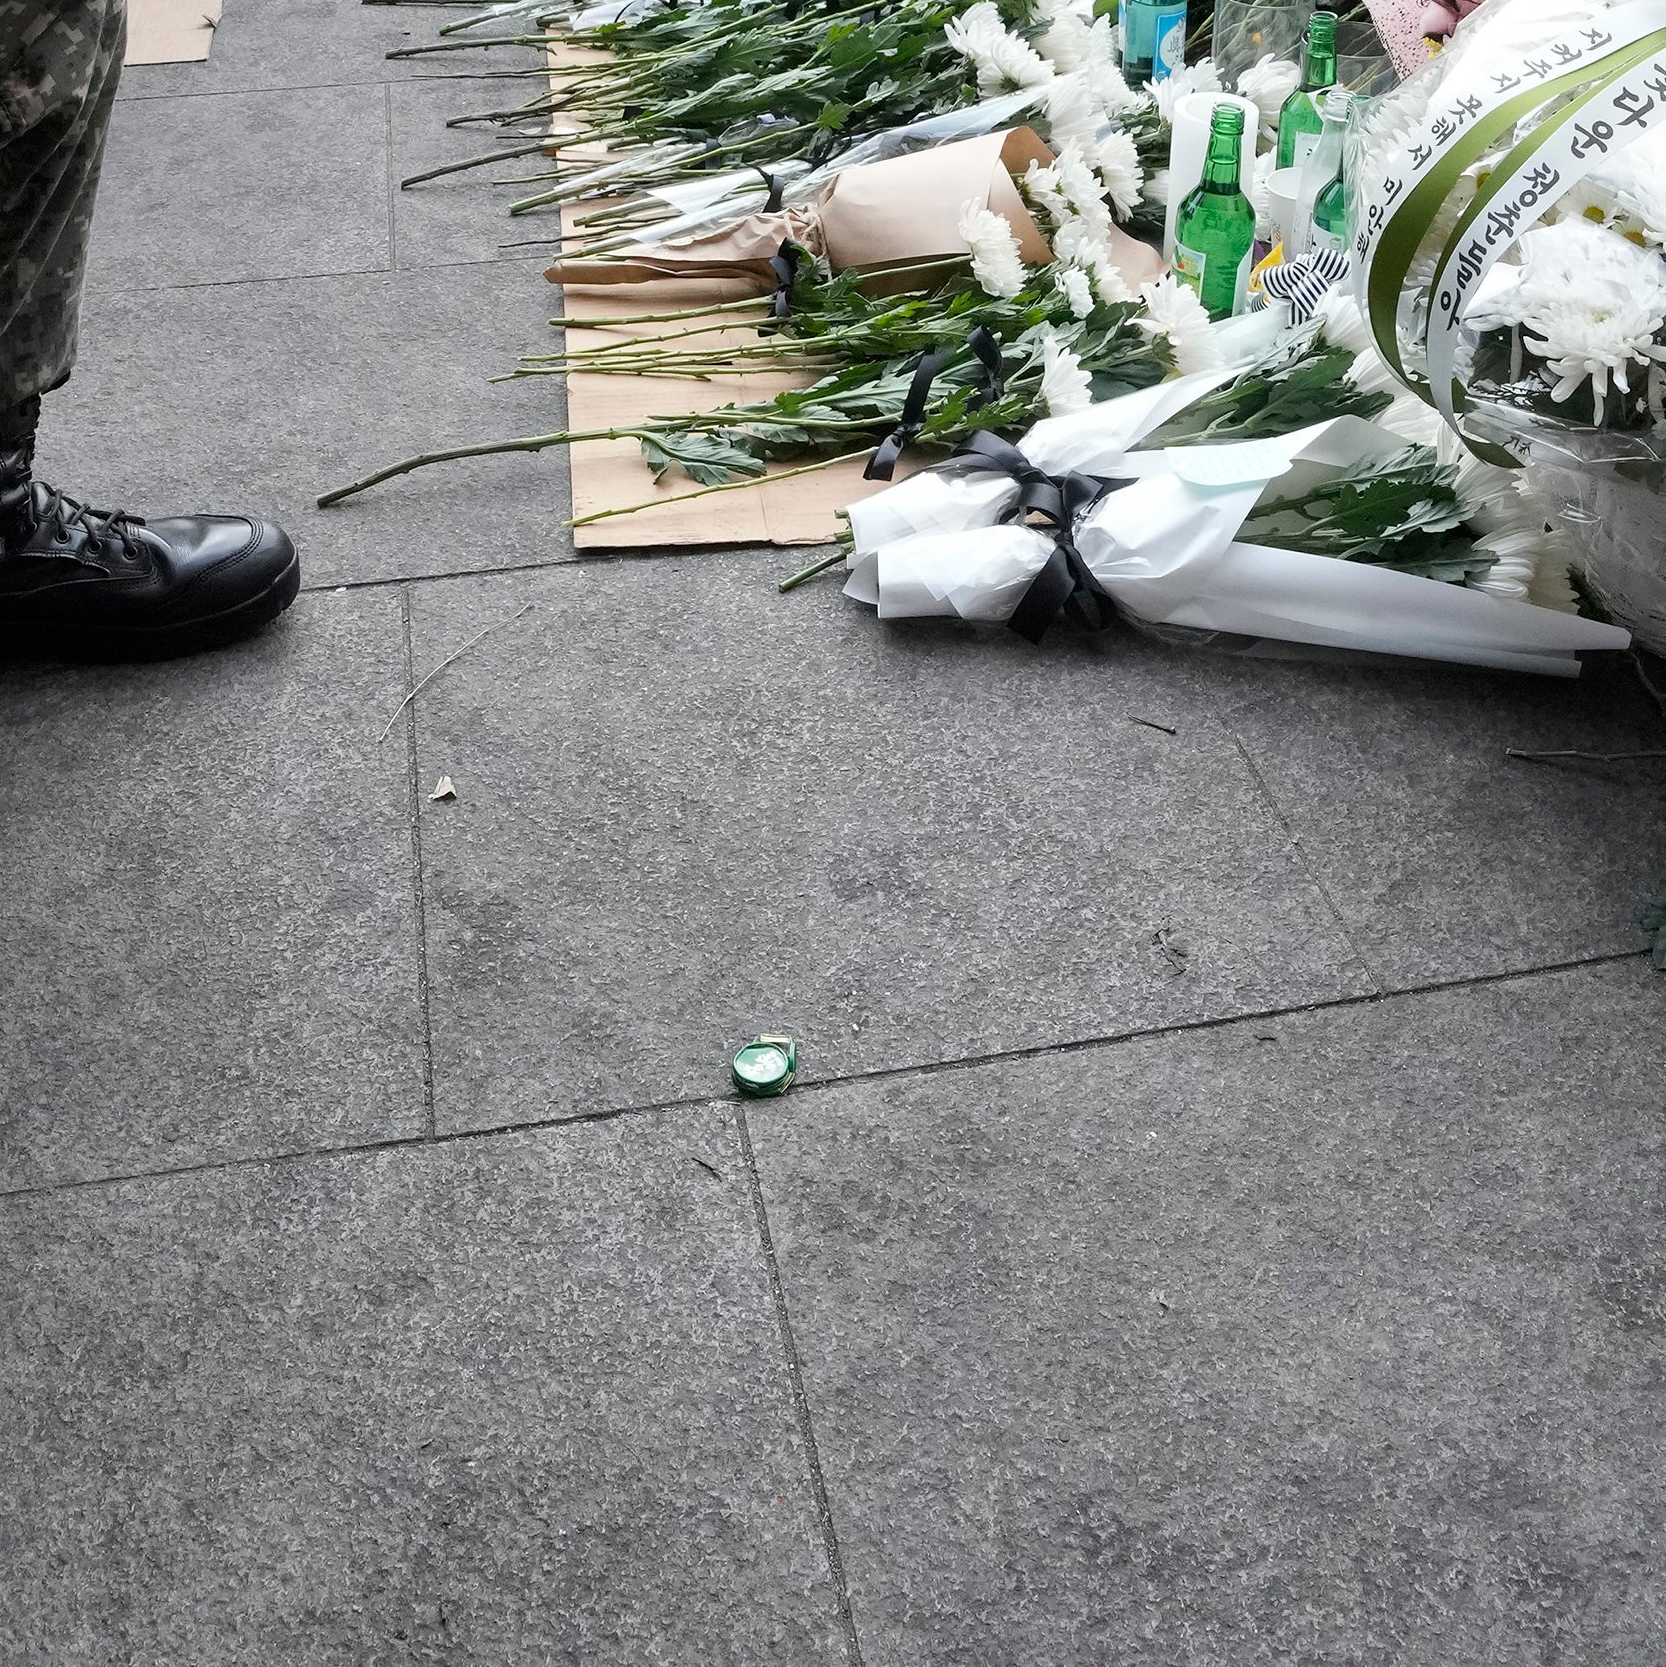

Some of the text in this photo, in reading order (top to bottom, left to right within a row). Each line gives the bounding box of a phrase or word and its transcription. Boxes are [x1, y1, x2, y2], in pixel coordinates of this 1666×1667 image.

[1355, 27, 1613, 265] 지켜주지 못해서 미안해
[1439, 161, 1562, 332] 청춘들아
